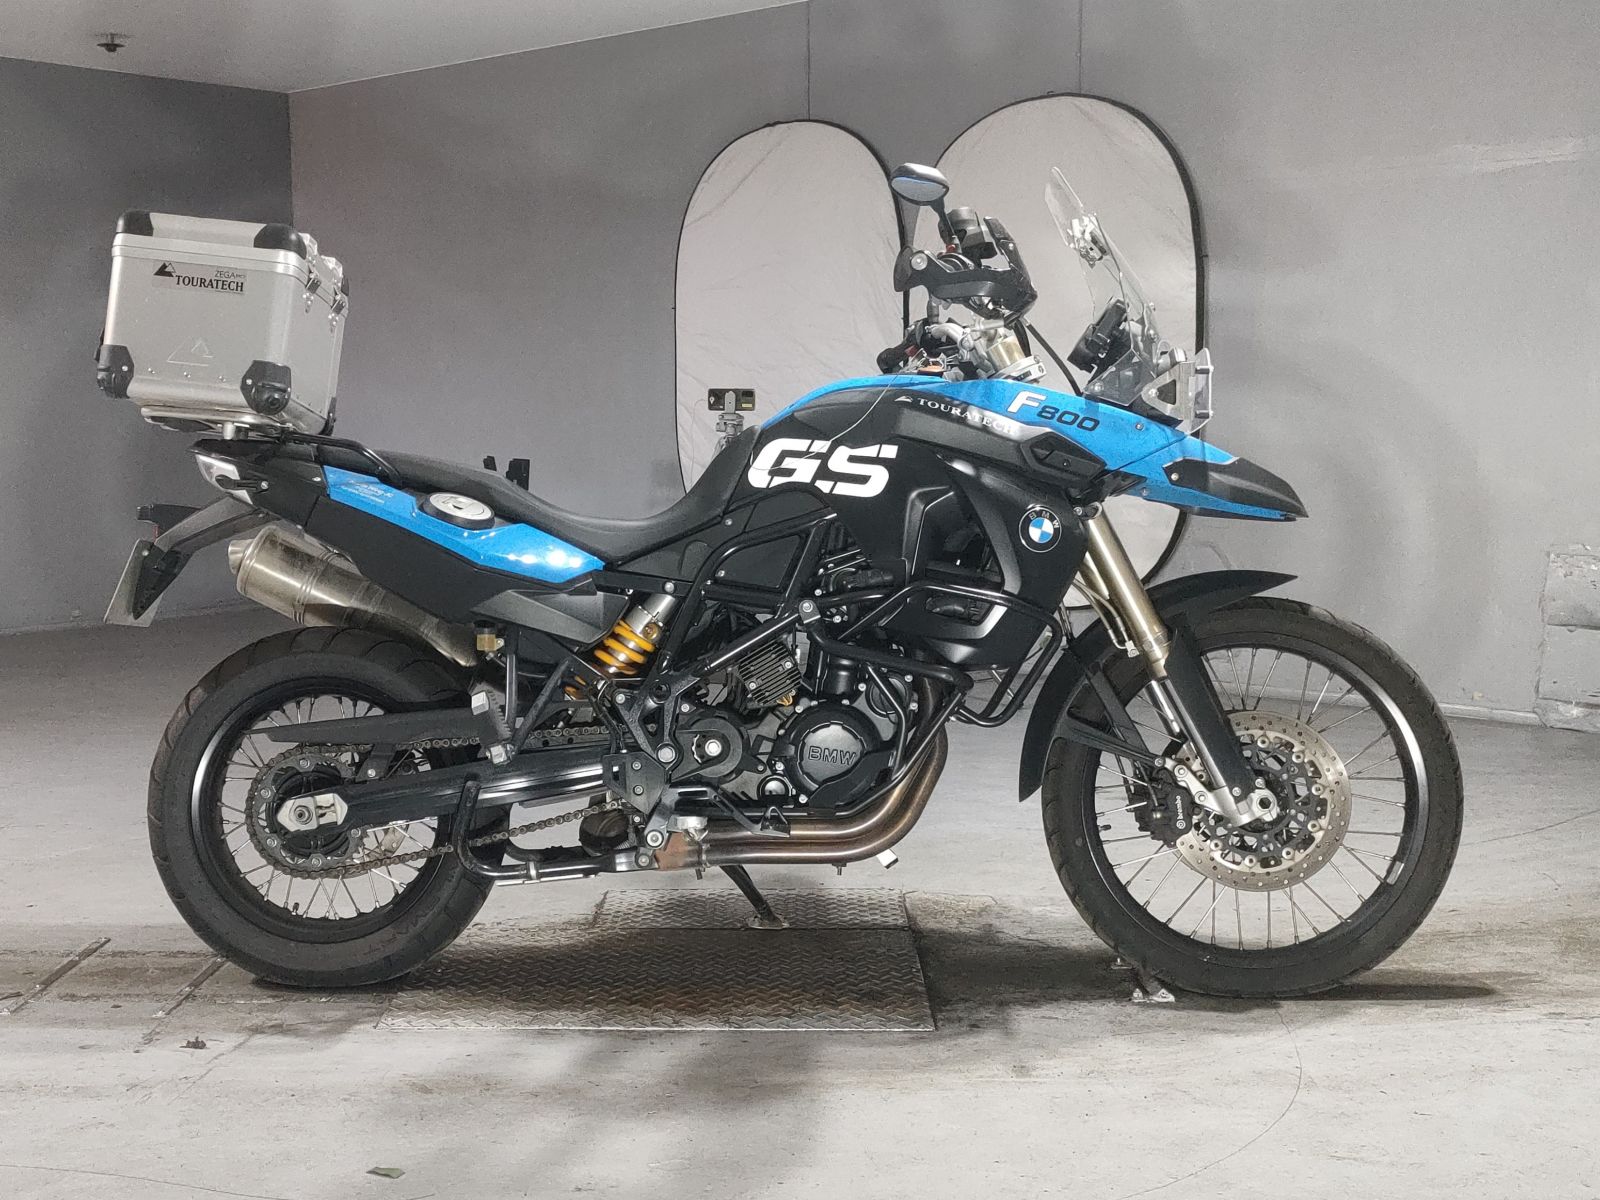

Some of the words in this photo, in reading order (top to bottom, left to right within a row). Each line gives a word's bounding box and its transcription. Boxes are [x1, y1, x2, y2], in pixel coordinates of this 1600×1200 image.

[175, 274, 244, 292] TOURATECH
[215, 270, 236, 279] ZEGA
[918, 397, 1018, 436] TOURATECH
[1007, 390, 1047, 413] F
[1037, 405, 1100, 431] 800
[748, 438, 898, 498] GS
[1029, 511, 1060, 529] BMW
[808, 745, 857, 766] BMW
